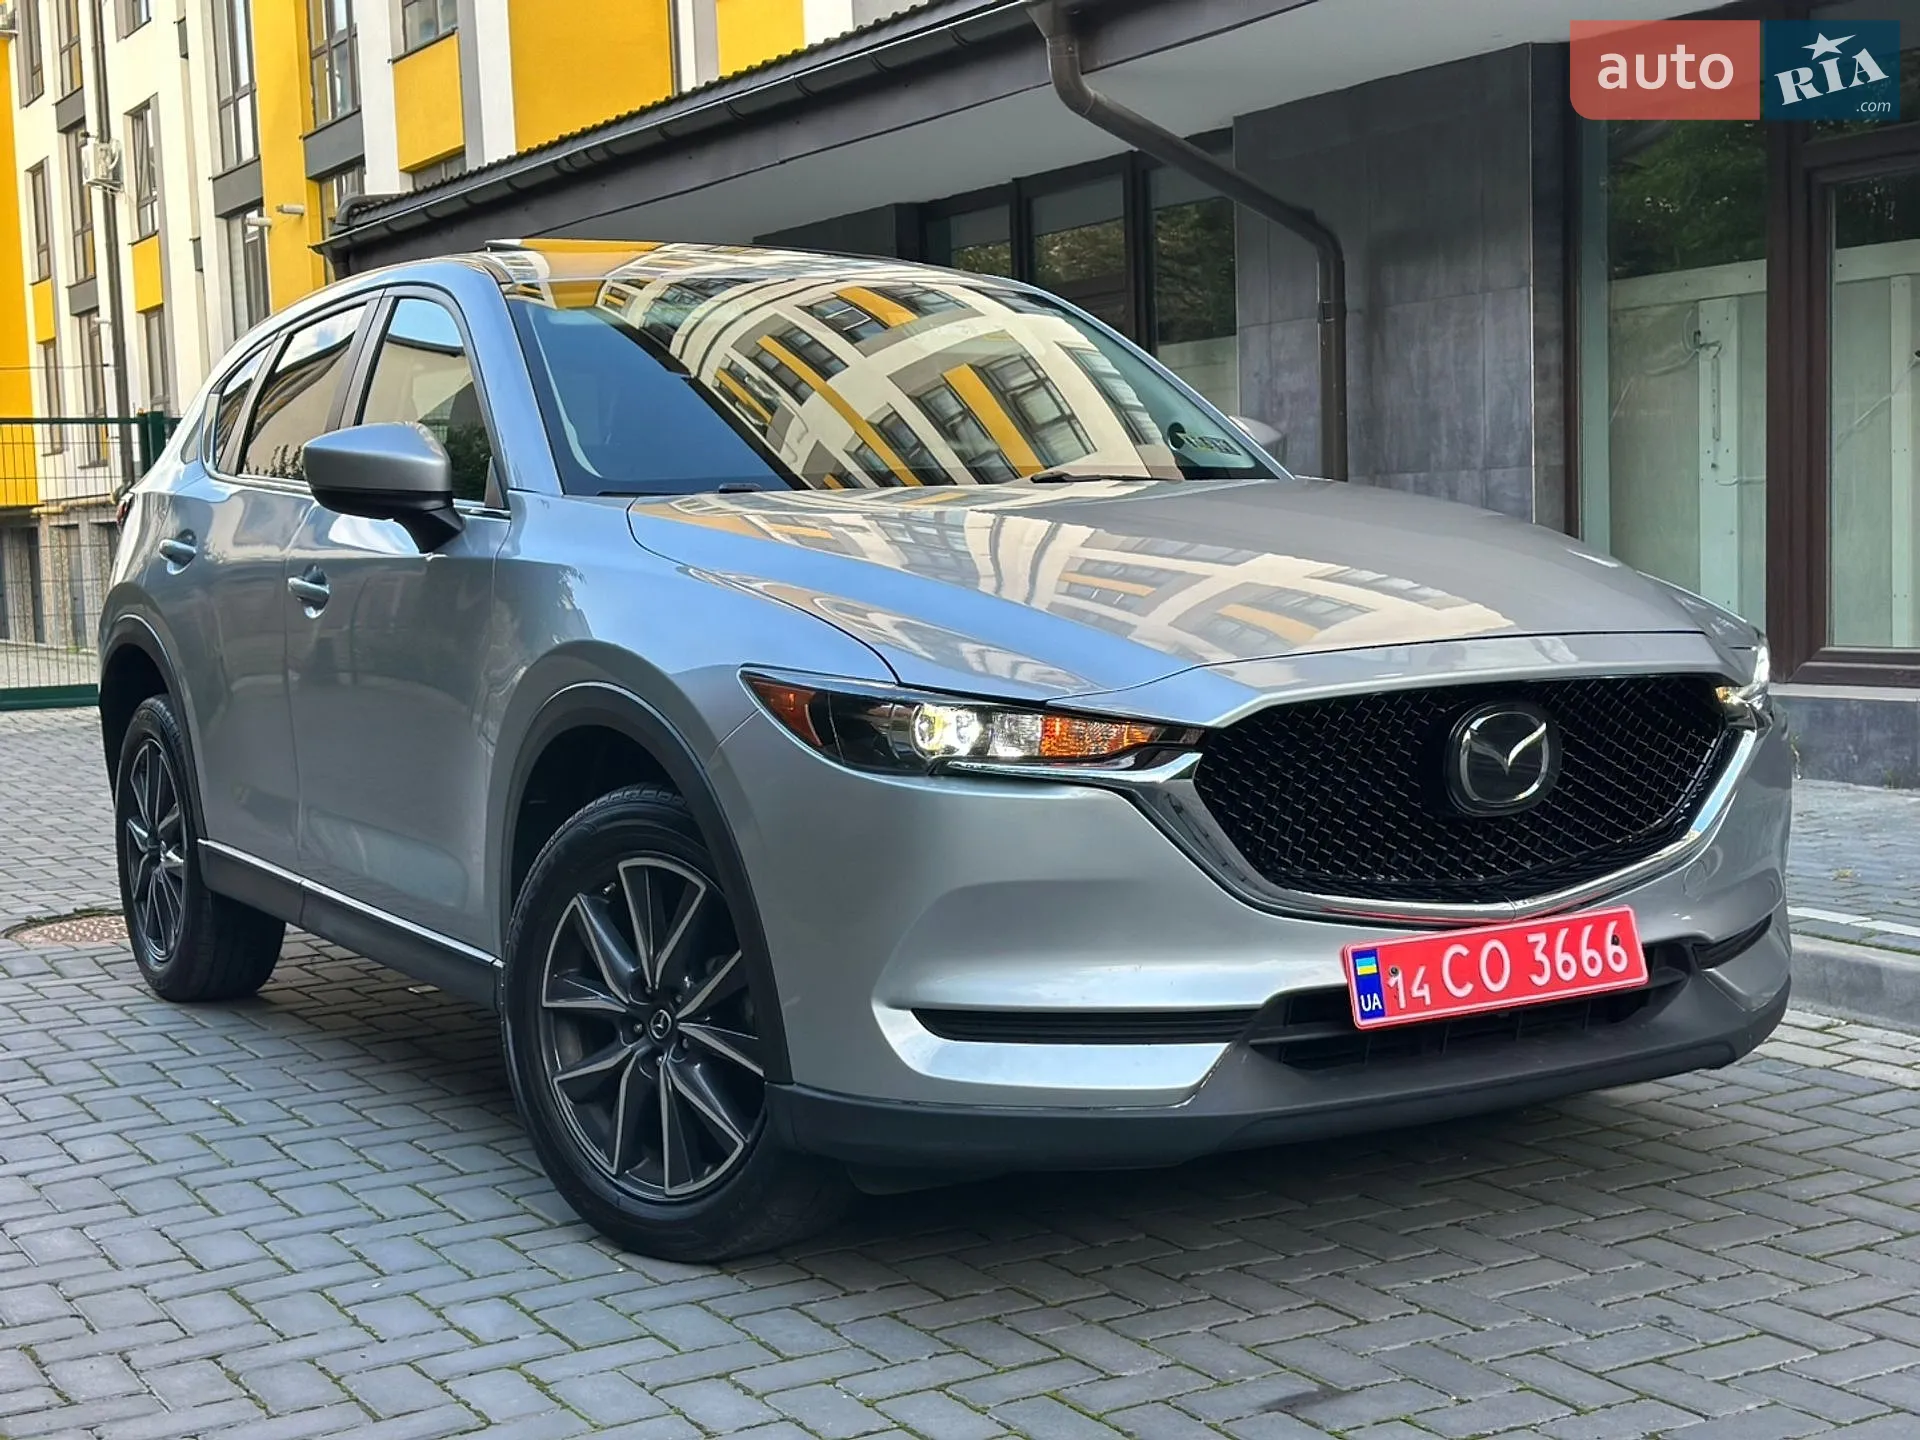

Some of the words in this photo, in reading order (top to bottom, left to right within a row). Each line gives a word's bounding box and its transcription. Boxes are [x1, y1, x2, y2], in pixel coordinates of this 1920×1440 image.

[1360, 992, 1383, 1012] UA
[1387, 965, 1431, 1009] 14
[1441, 940, 1510, 998] CO
[1527, 920, 1629, 987] 3666
